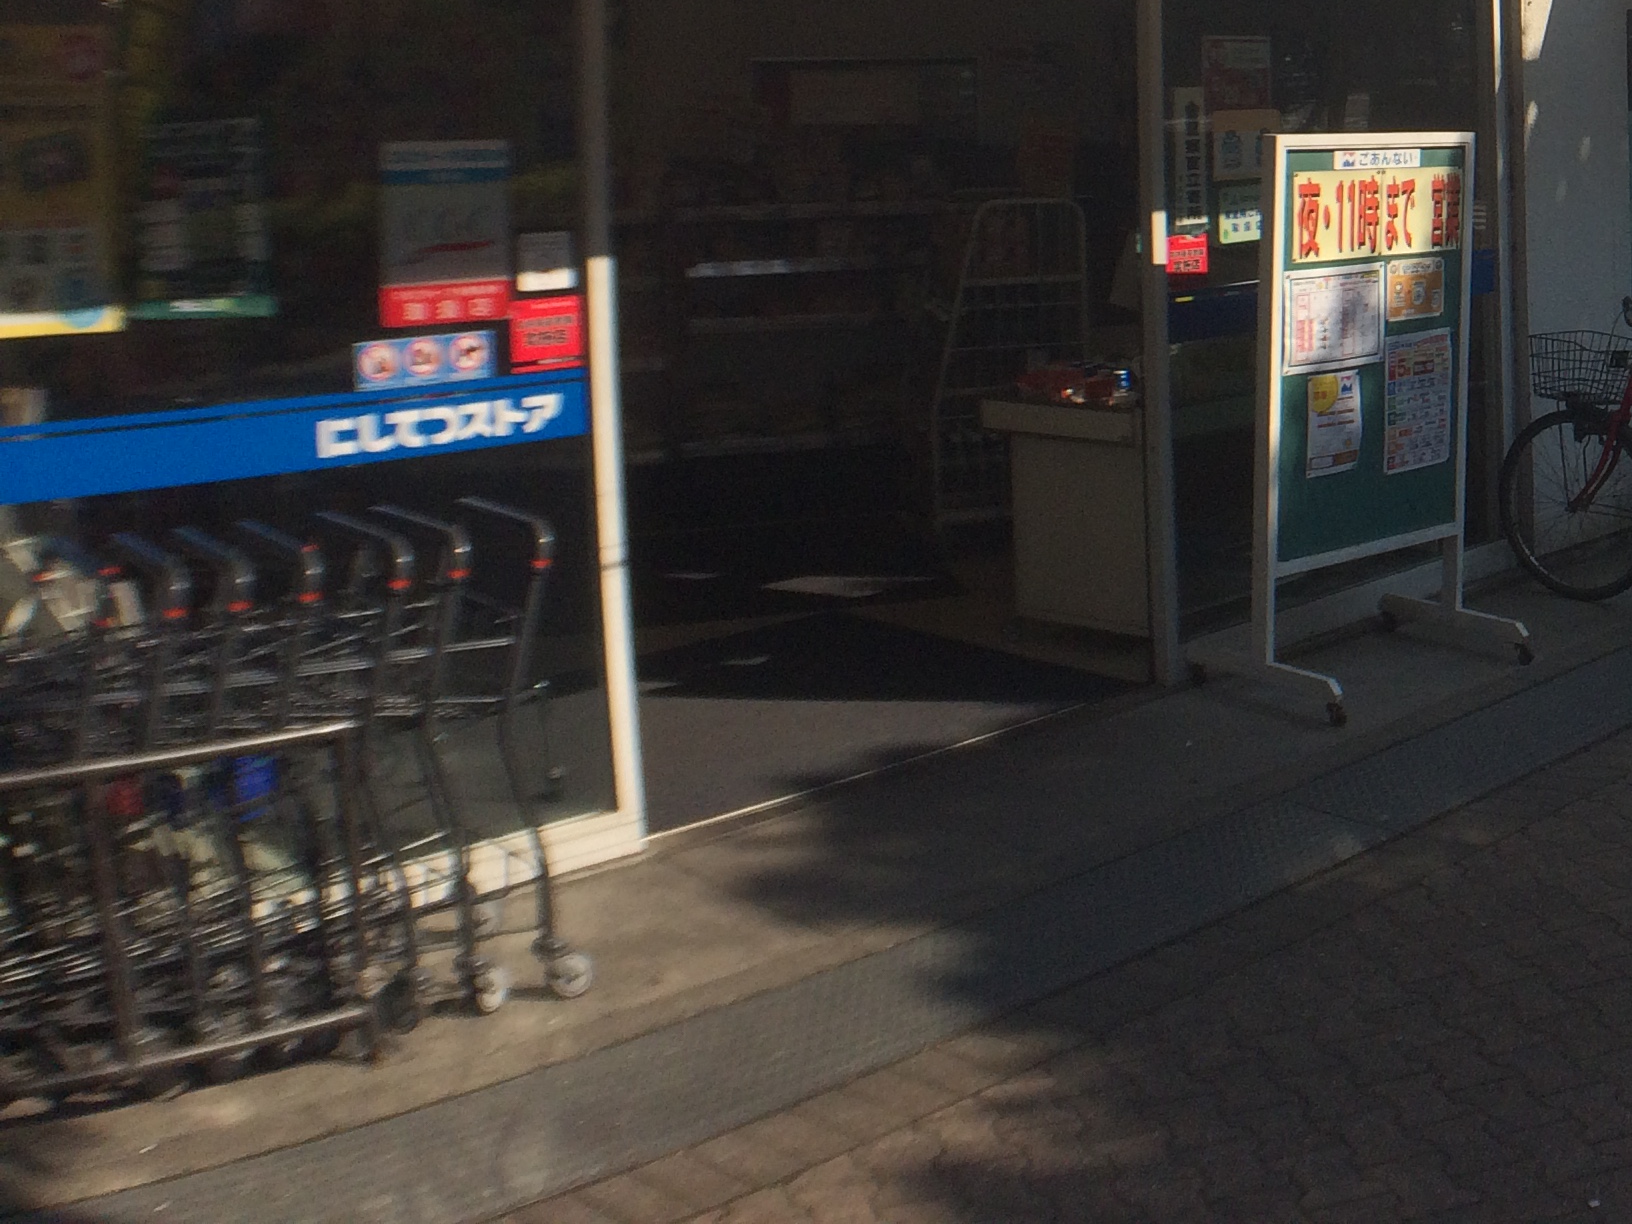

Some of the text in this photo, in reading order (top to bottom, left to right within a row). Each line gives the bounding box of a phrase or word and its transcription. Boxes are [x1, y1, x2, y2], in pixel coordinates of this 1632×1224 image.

[1359, 151, 1413, 167] ごあんない
[1430, 172, 1461, 249] 営業
[315, 392, 565, 461] にしてつストア
